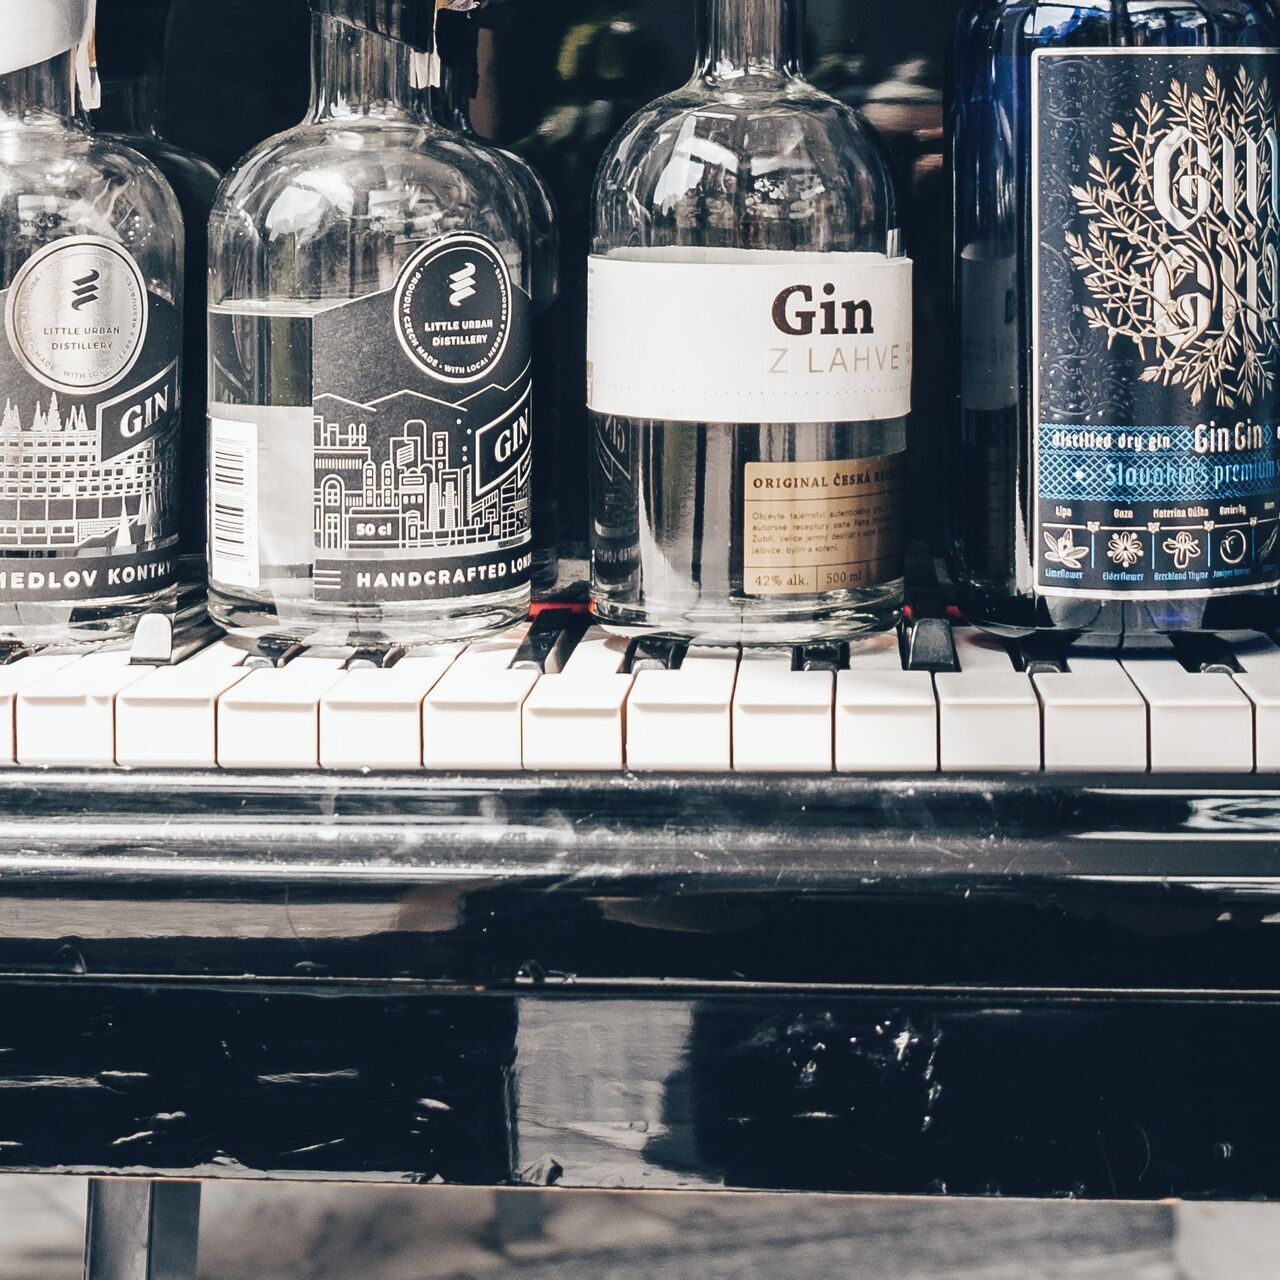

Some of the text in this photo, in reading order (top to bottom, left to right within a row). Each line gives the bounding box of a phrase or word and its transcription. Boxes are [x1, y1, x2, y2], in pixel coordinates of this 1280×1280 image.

[402, 271, 422, 314] PROUDLY
[772, 282, 874, 336] Gin
[43, 326, 120, 335] LITTLE URBAN
[403, 317, 418, 347] CZECH
[423, 318, 493, 332] LITTLE URBAN
[51, 341, 113, 350] DISTILLERY
[432, 334, 488, 347] DISTILLERY
[488, 331, 503, 358] HERBS
[416, 345, 438, 368] MADE
[466, 357, 489, 373] LOCAL
[769, 348, 789, 373] Z
[808, 344, 900, 374] LAHVE
[64, 370, 86, 378] WITH
[444, 364, 465, 374] WITH
[120, 384, 169, 438] GIN
[494, 407, 529, 463] GIN
[1052, 431, 1112, 449] distilled
[1118, 433, 1142, 452] dry
[1148, 433, 1171, 452] gin
[1194, 420, 1230, 454] Gin
[1234, 418, 1263, 451] Gin
[753, 476, 828, 489] ORIGINAL
[833, 471, 871, 487] ČESKÁ
[1215, 460, 1275, 489] premium
[1055, 505, 1072, 519] Lipa
[356, 523, 392, 536] 50 cl
[793, 523, 829, 531] receptury
[356, 562, 507, 588] HANDCRAFTED
[754, 569, 862, 587] 42% alk. 500 ml
[1045, 568, 1084, 580] Limeflower
[1187, 570, 1209, 582] Thyme
